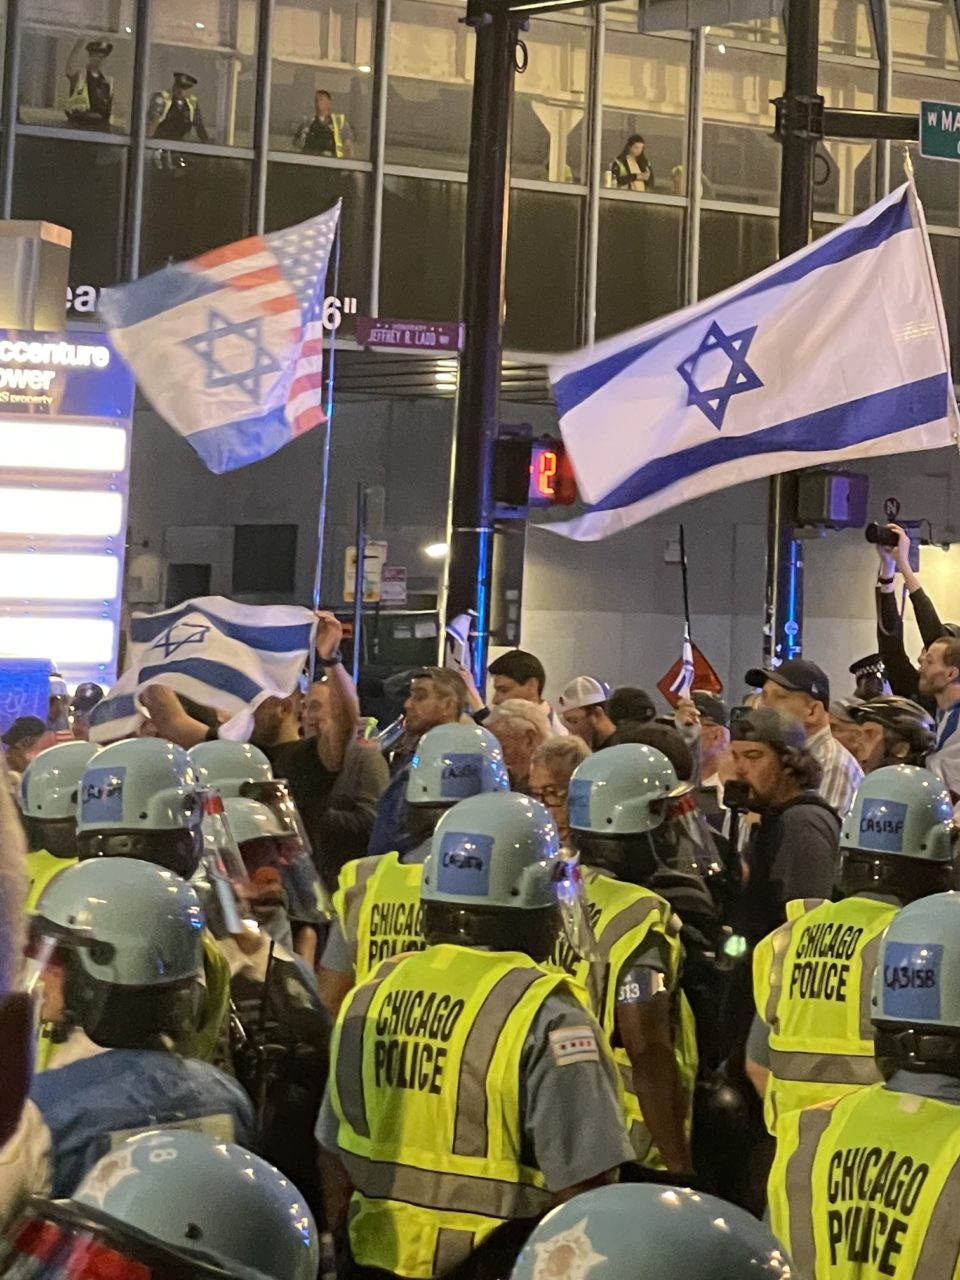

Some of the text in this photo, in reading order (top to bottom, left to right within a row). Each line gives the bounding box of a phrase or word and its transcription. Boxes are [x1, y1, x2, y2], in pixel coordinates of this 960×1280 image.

[927, 111, 938, 127] W
[0, 340, 110, 368] ccenture
[368, 328, 401, 344] JEFFREY
[415, 331, 436, 347] LADD
[796, 923, 864, 961] CHICAGO
[790, 961, 850, 1002] POLICE
[376, 990, 465, 1042] CHICAGO
[374, 1039, 448, 1095] POLICE
[828, 1146, 929, 1216] CHICAGO
